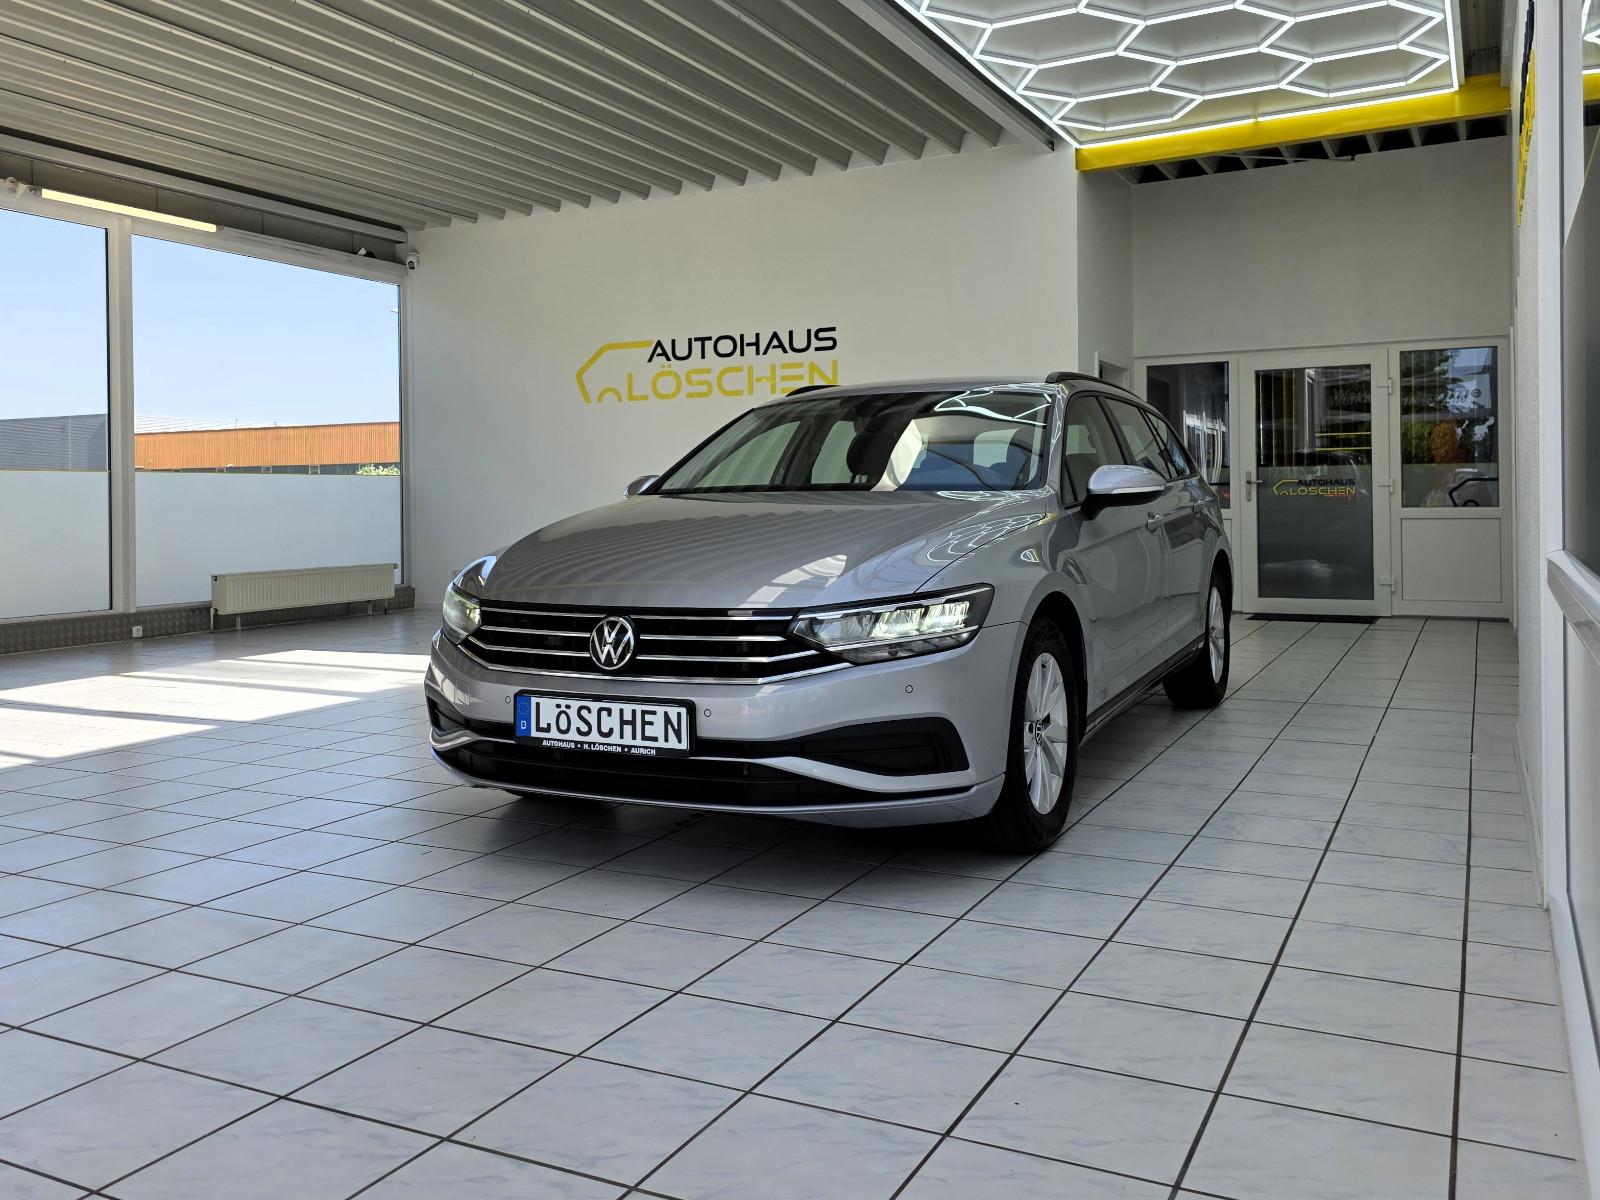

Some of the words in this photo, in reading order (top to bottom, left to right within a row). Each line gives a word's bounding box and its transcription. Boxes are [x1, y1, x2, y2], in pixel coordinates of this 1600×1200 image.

[647, 326, 838, 363] AUTOHAUS
[627, 359, 838, 401] LÖSCHEN
[1296, 478, 1355, 486] AUTOHAUS
[535, 701, 682, 744] LÖSCHEN
[542, 739, 575, 749] AUTOHAUS
[591, 742, 622, 753] LÖSCHEN
[630, 747, 656, 756] AURICH
